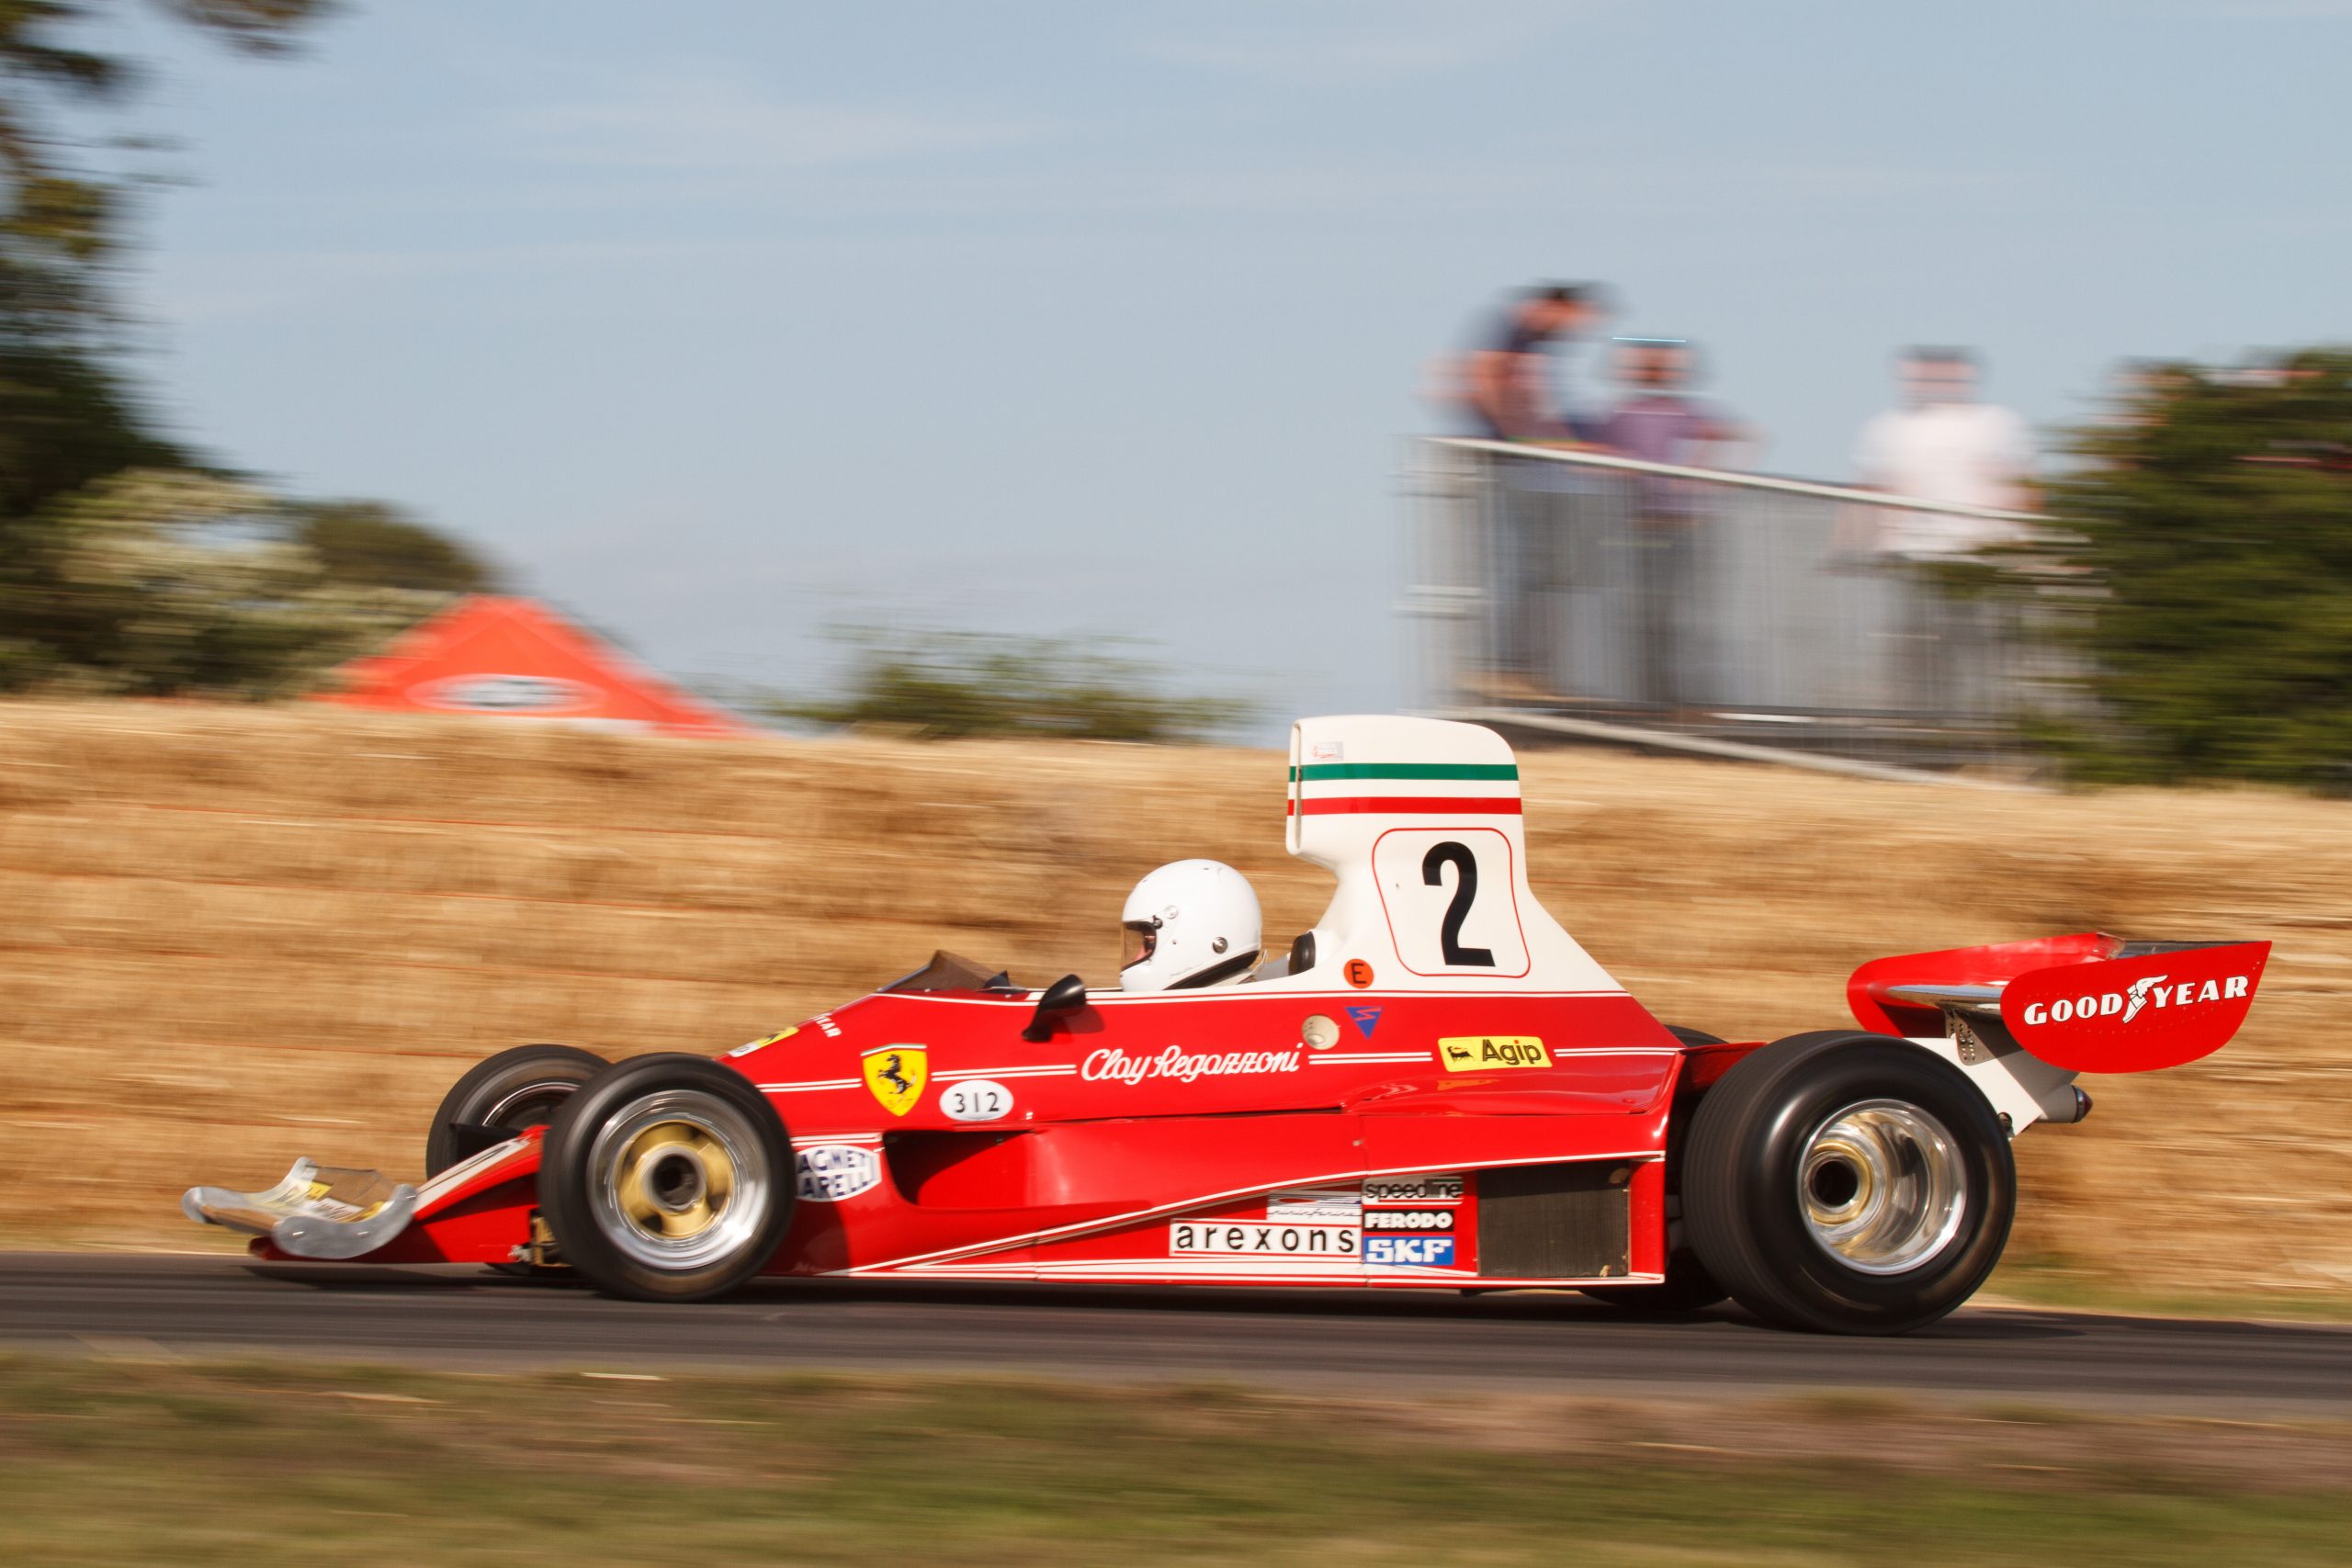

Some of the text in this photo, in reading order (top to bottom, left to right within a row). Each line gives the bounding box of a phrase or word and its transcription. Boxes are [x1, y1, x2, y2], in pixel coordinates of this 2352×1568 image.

[1421, 840, 1496, 967] 2
[1351, 963, 1366, 984] E
[2023, 975, 2249, 1025] GOOD YEAR
[1081, 1043, 1304, 1085] Clay Regazzoni
[1482, 1039, 1542, 1066] Agip
[955, 1091, 1000, 1113] 312
[1366, 1183, 1463, 1199] speedne
[1364, 1212, 1453, 1229] FERODO
[1176, 1224, 1354, 1253] arexons
[1365, 1239, 1452, 1263] SKF
